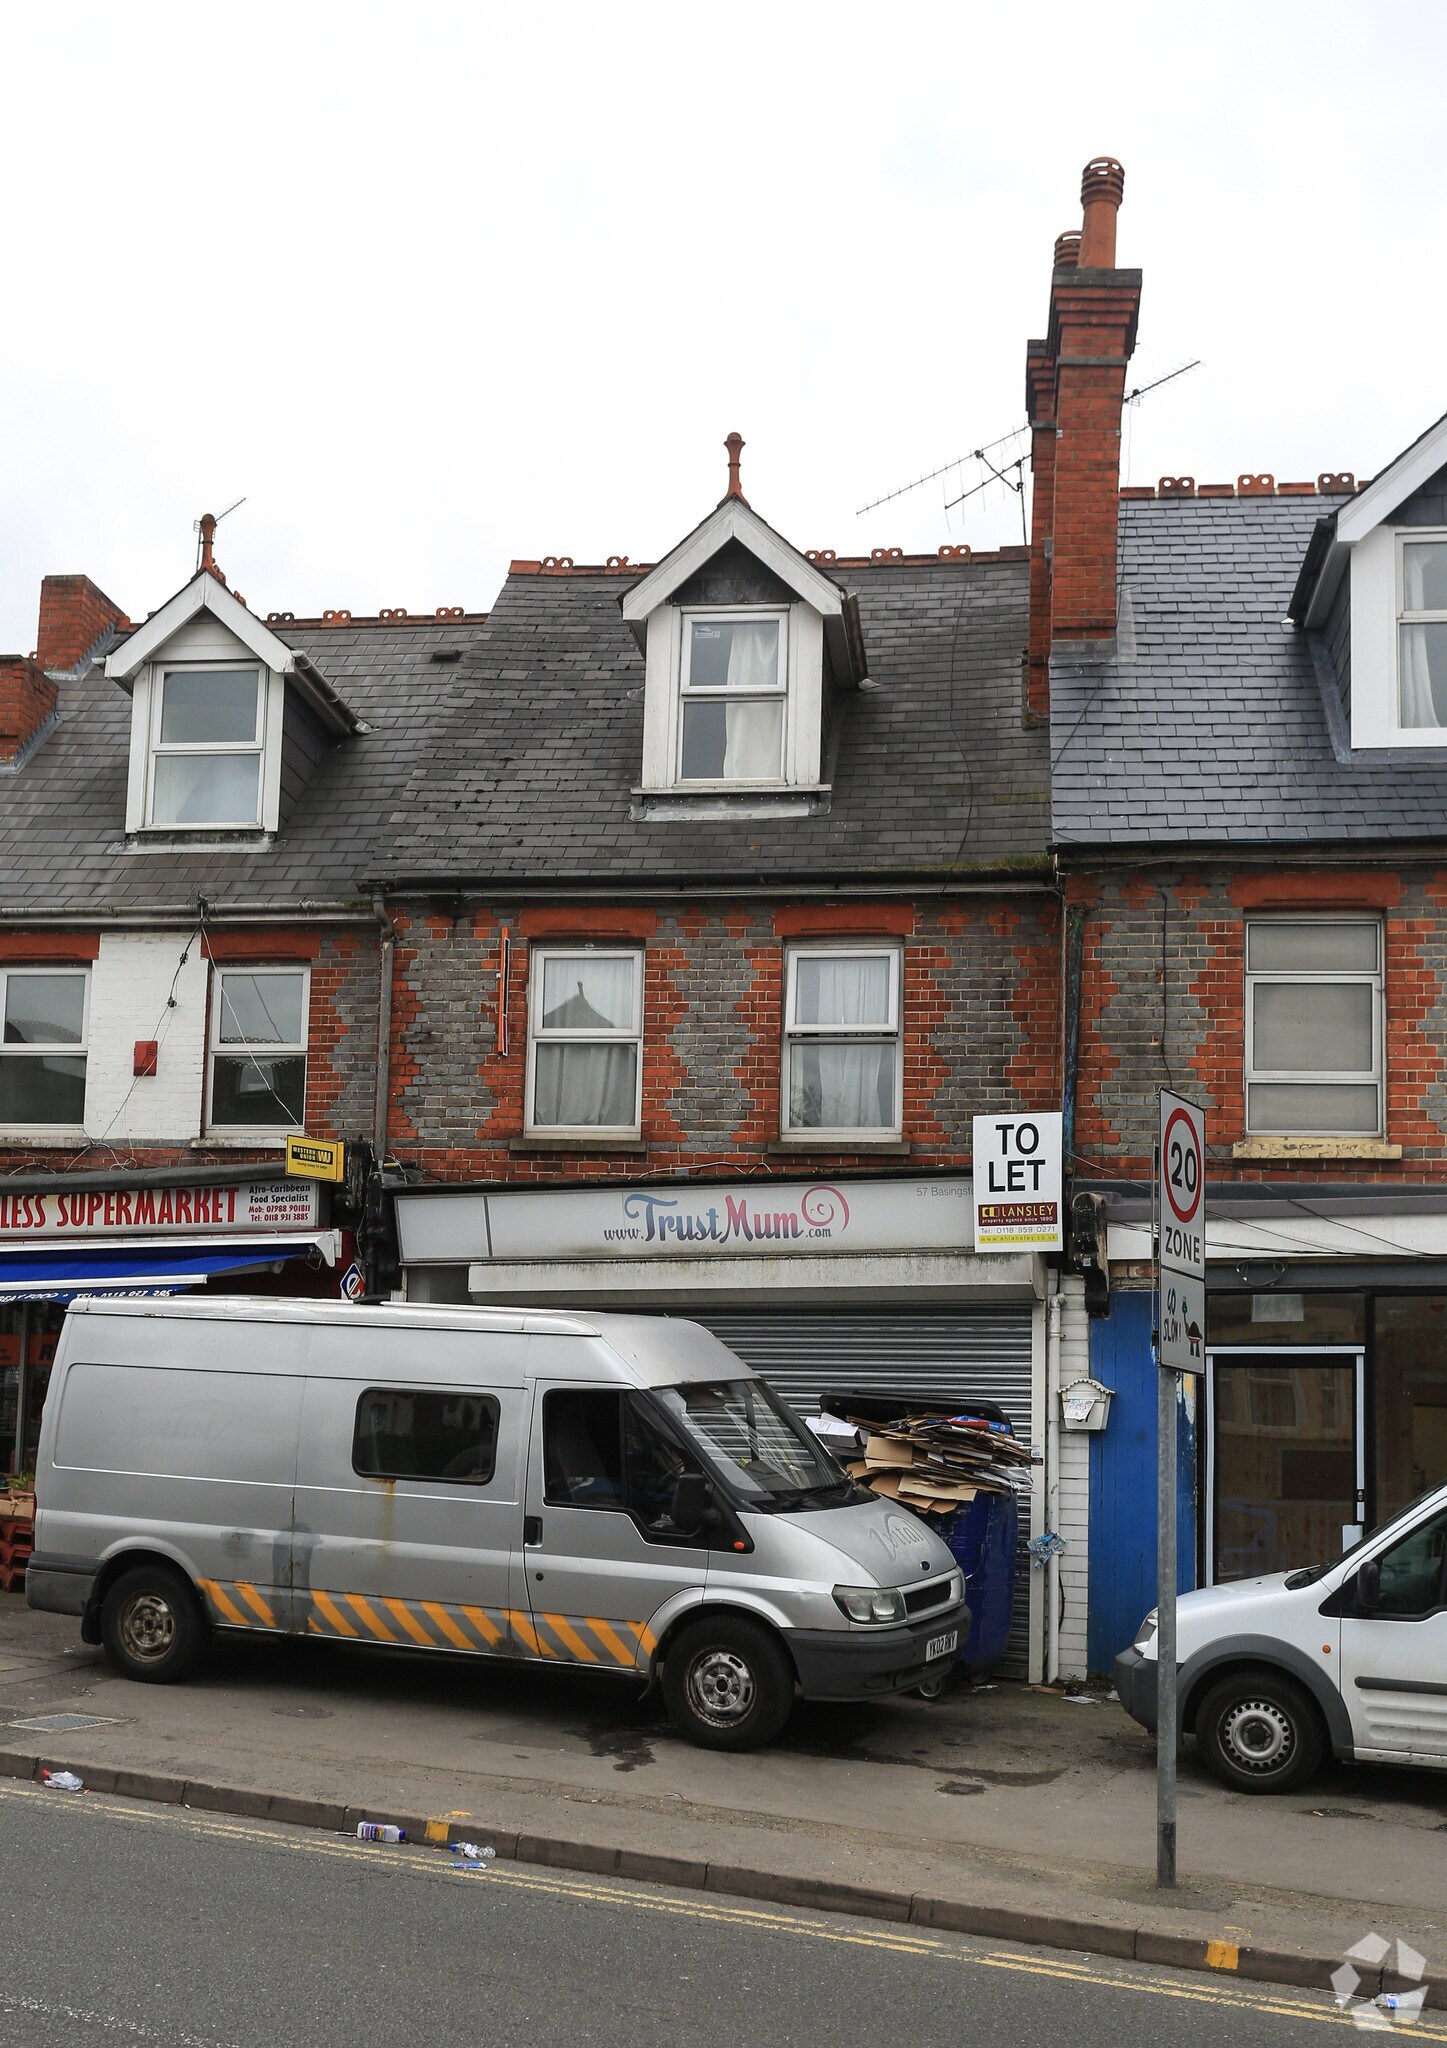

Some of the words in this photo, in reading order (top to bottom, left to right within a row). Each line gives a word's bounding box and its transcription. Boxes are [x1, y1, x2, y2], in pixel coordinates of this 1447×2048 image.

[995, 1122, 1040, 1155] TO
[292, 1146, 316, 1156] WESTERN
[299, 1153, 316, 1161] UNION
[317, 1150, 332, 1164] WU
[1170, 1140, 1197, 1194] 20
[988, 1159, 1046, 1192] LET
[249, 1184, 311, 1194] Afro-Caribbean
[916, 1187, 928, 1197] 57
[250, 1195, 269, 1204] Food
[271, 1194, 309, 1204] Specialist
[56, 1187, 240, 1227] SUPERMARKET
[249, 1205, 264, 1213] Mob:
[266, 1204, 287, 1213] 07988
[289, 1204, 311, 1212] 901811
[1001, 1205, 1054, 1217] LANSLEY
[251, 1214, 262, 1222] Tel:
[264, 1213, 279, 1221] 0118
[280, 1213, 291, 1221] 931
[292, 1212, 309, 1220] 3885
[981, 1217, 1004, 1225] property
[996, 1226, 1014, 1234] 0118
[1036, 1225, 1055, 1233] 0271
[1165, 1225, 1200, 1264] ZONE
